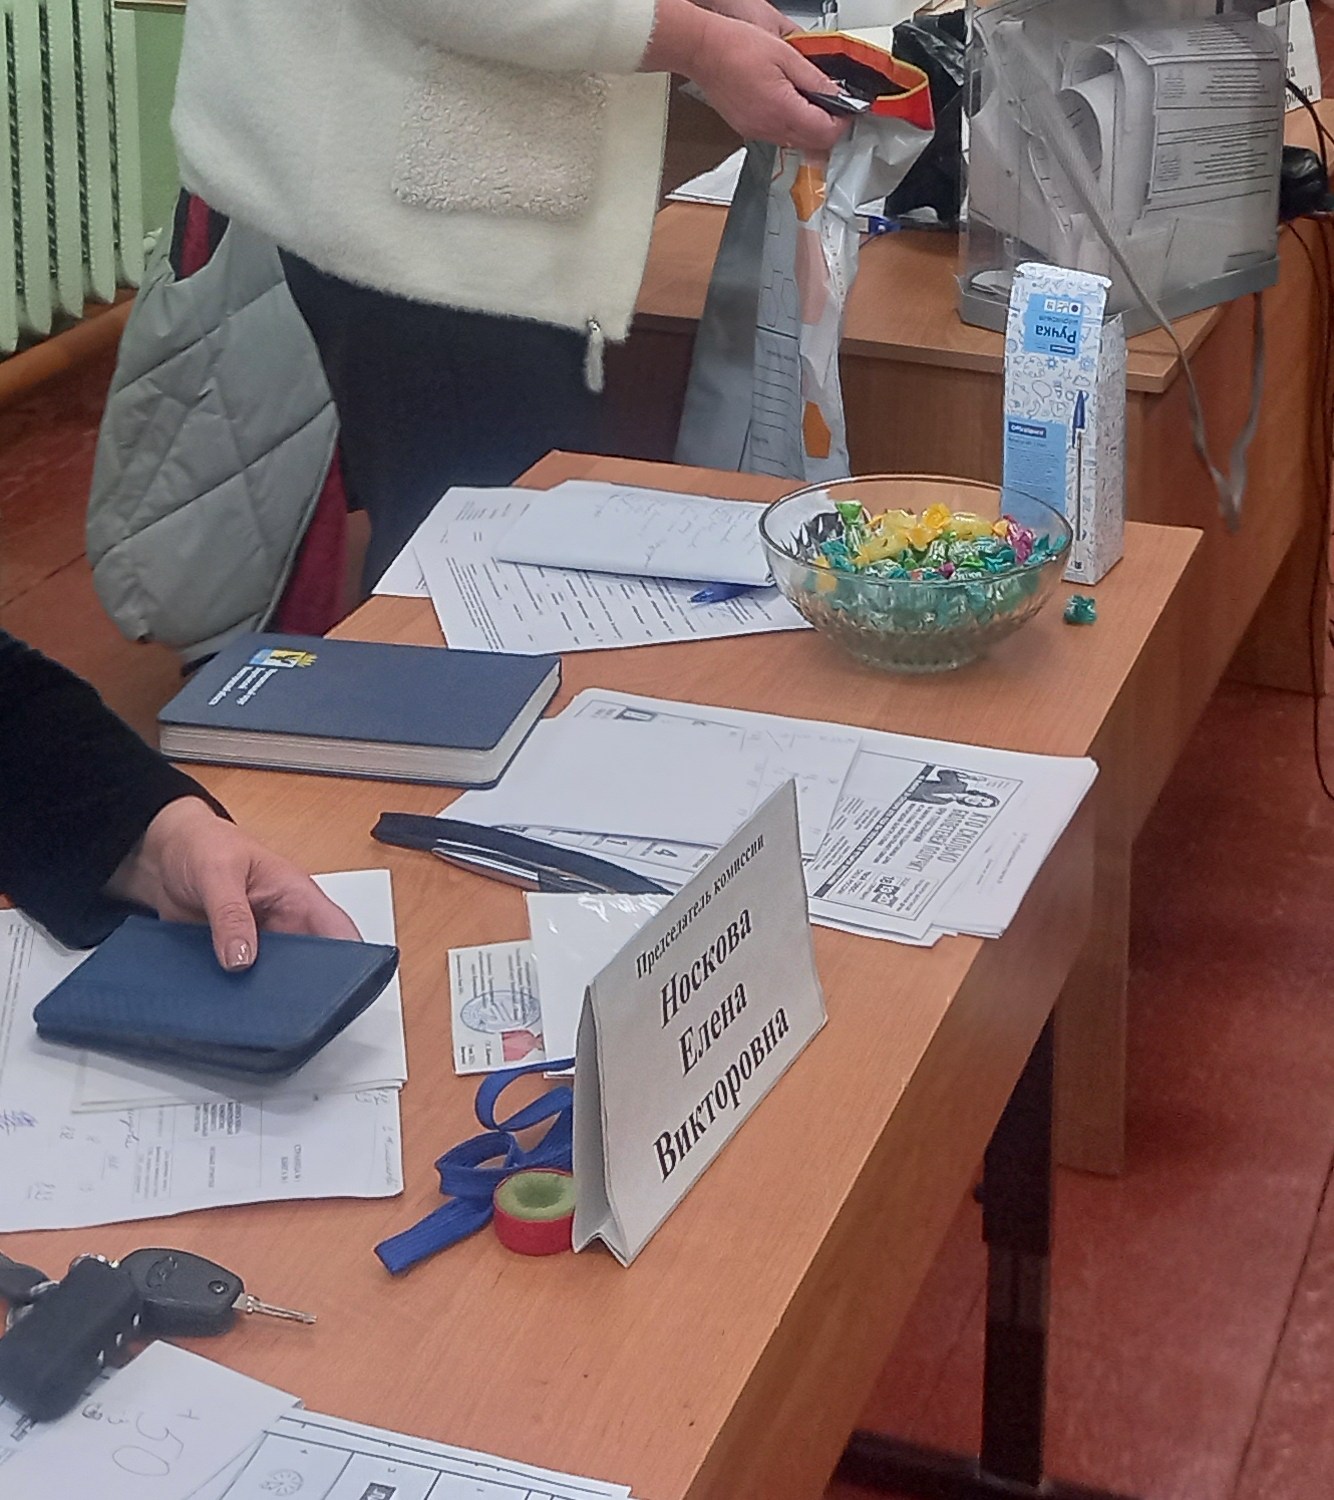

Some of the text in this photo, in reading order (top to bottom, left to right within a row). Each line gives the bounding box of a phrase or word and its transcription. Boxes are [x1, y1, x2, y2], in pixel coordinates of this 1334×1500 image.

[1035, 325, 1077, 343] Ручка
[636, 834, 765, 979] Председатель комиссии
[660, 909, 753, 1029] Носкова
[679, 982, 748, 1078] Елена
[653, 1007, 790, 1183] Викторовна
